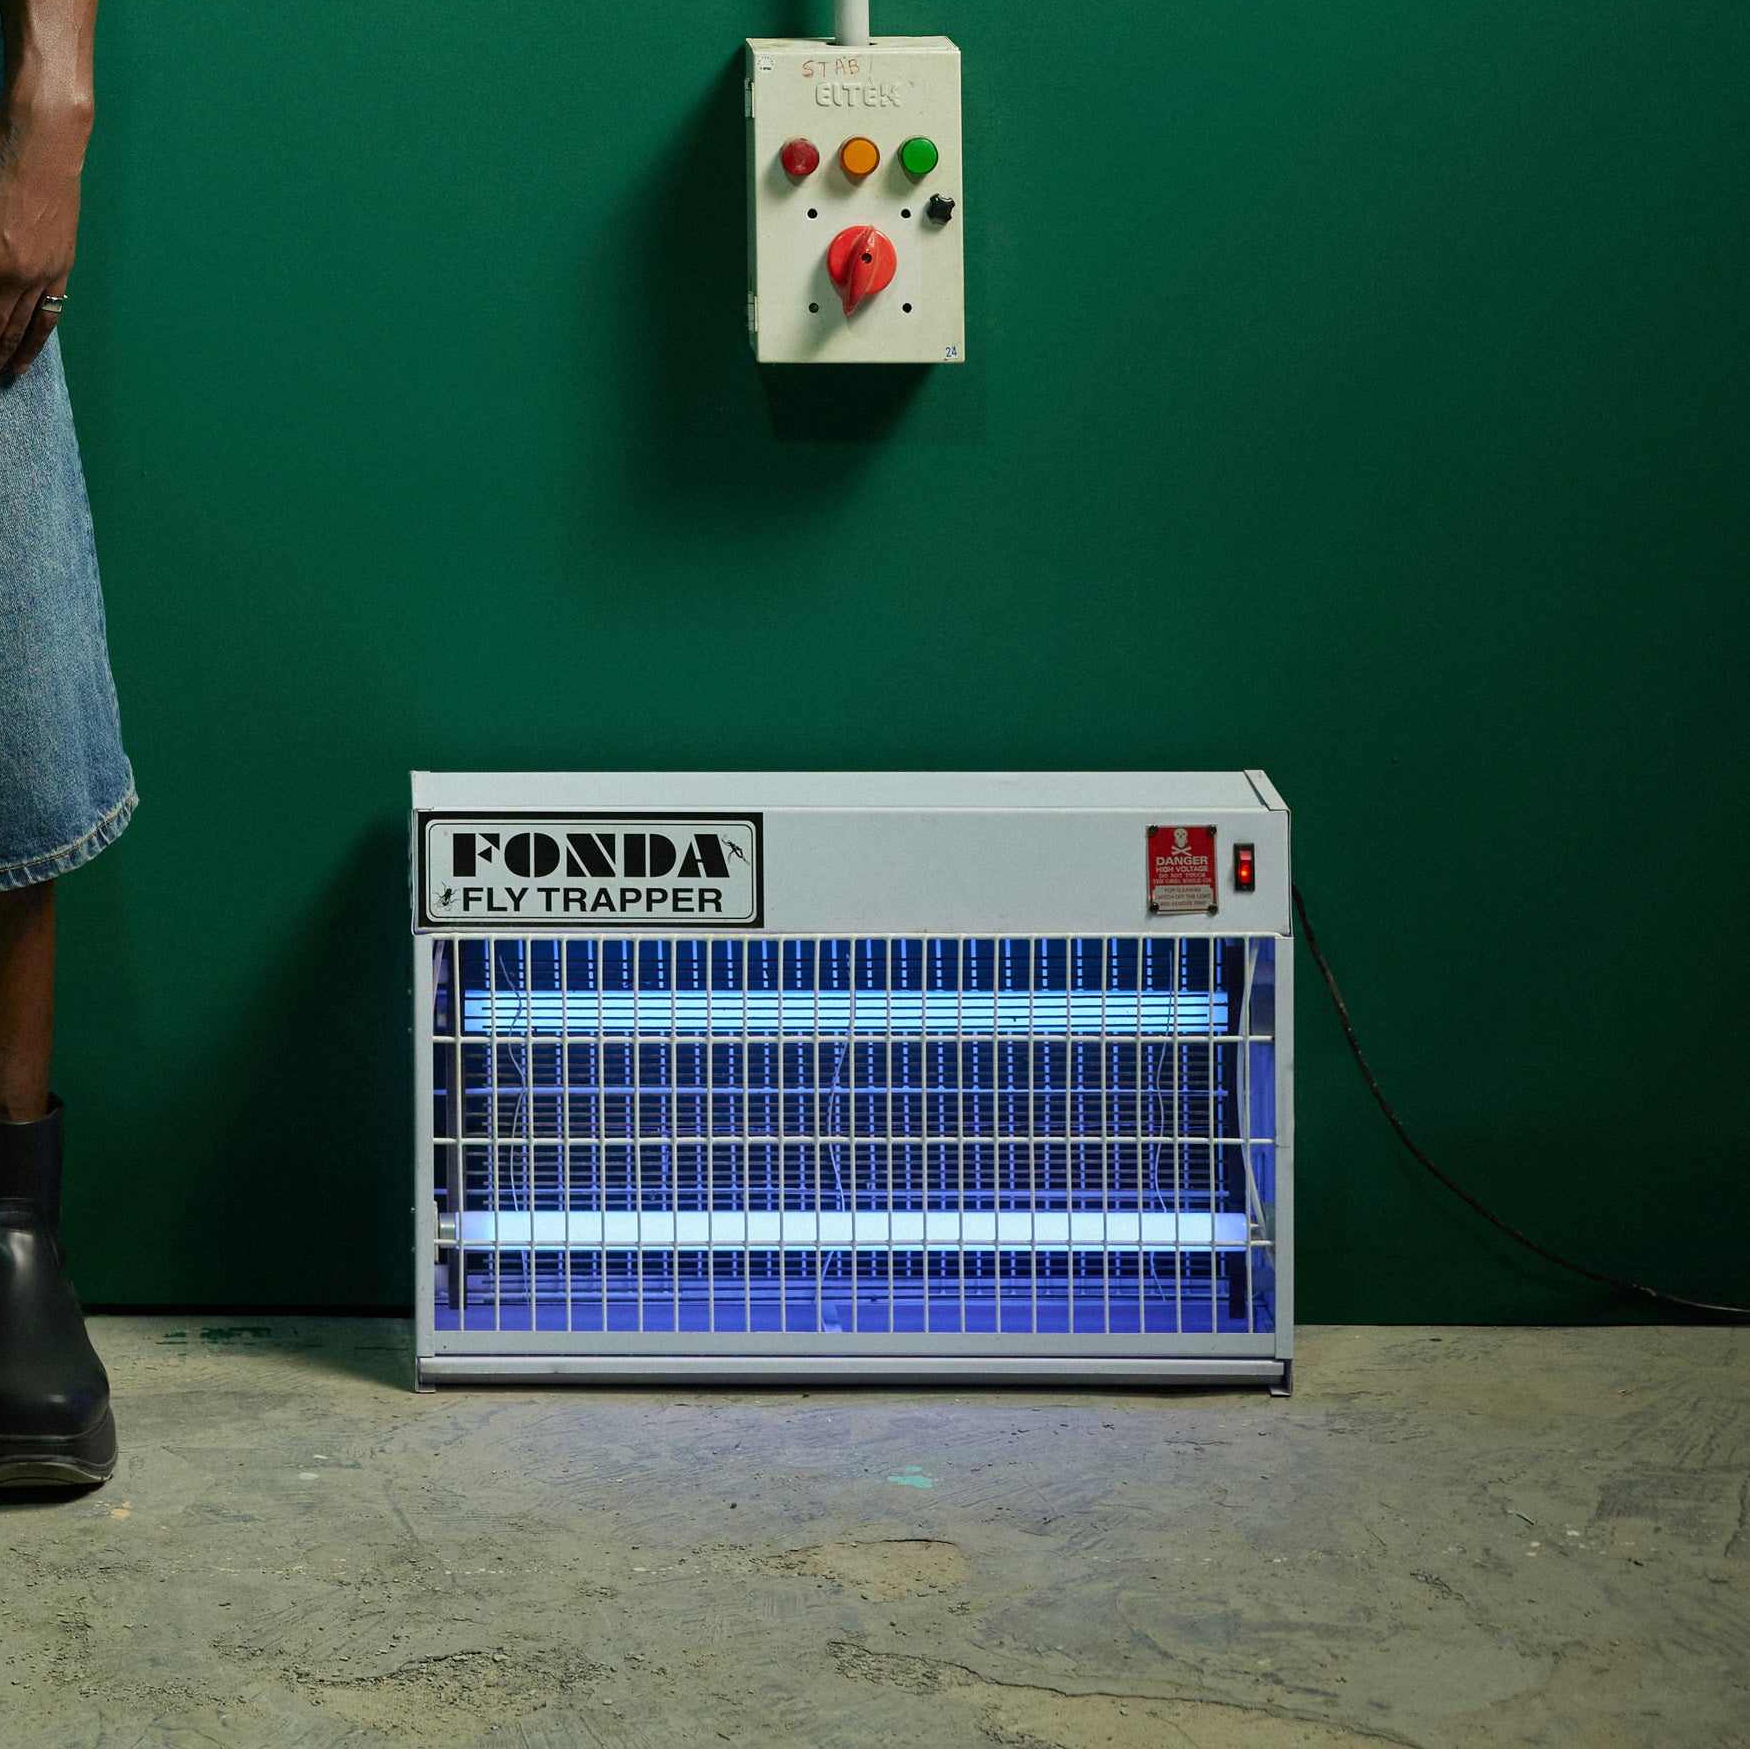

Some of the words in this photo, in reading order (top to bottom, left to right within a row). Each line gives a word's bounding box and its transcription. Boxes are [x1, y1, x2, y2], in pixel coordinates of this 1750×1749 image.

[802, 59, 860, 78] STAB
[945, 346, 958, 358] 24
[453, 832, 730, 878] FONDA
[1156, 856, 1208, 866] DANGER
[463, 887, 529, 912] FLY
[537, 887, 723, 913] TRAPPER
